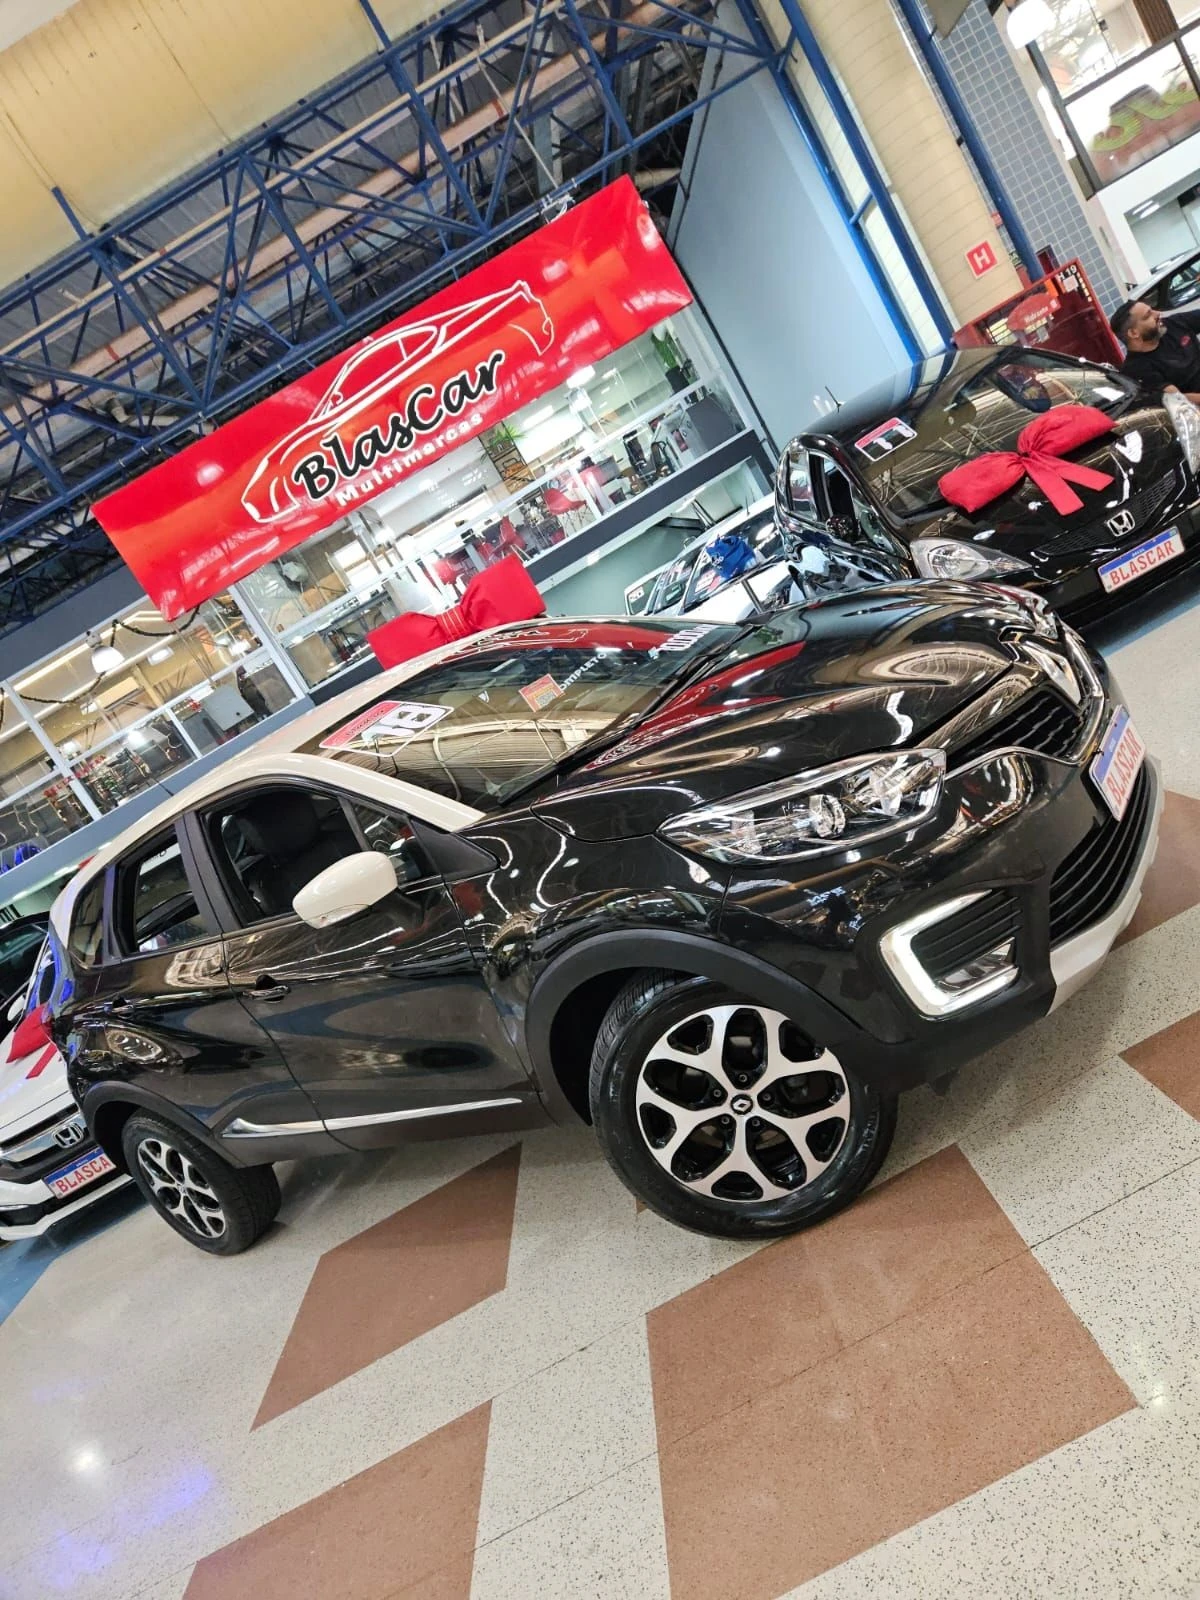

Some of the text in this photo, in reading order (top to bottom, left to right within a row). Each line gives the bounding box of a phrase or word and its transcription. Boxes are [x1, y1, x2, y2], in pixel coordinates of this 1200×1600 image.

[292, 350, 505, 501] BlasCar
[334, 412, 484, 507] Multimarcas
[1109, 540, 1176, 585] BLASCAR
[559, 651, 608, 692] OMPLETO
[1105, 726, 1143, 807] BLASCAR
[55, 1155, 113, 1193] BLASCA
